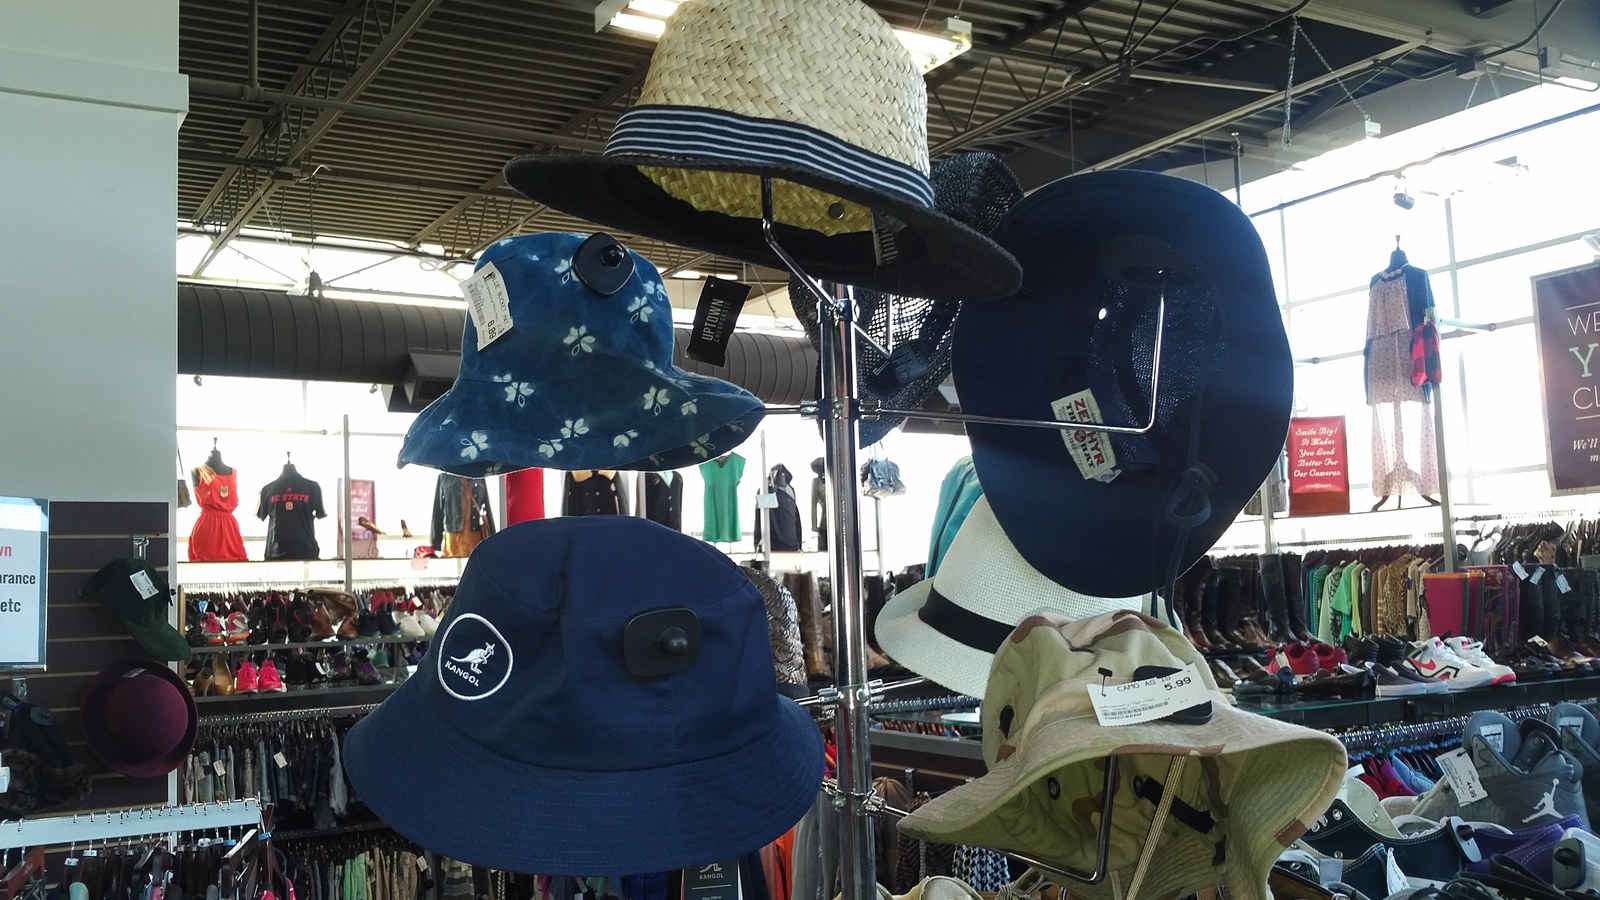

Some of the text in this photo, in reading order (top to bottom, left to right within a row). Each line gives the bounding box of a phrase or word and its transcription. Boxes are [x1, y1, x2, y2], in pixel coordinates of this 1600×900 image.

[497, 291, 507, 312] BUCKET
[701, 298, 724, 341] UPTOWN
[1295, 427, 1338, 437] Smile Big!
[1311, 438, 1335, 446] Makes
[1573, 437, 1598, 451] We'll
[1299, 447, 1336, 458] You Look
[1297, 458, 1339, 467] Better For
[1293, 469, 1342, 477] Our Cameras.
[282, 493, 309, 502] STATE
[0, 574, 36, 585] rance
[0, 598, 21, 613] etc
[445, 660, 479, 687] KANGOL
[1117, 683, 1140, 692] CAMO
[1144, 679, 1157, 687] AS
[1164, 677, 1192, 691] 5.99
